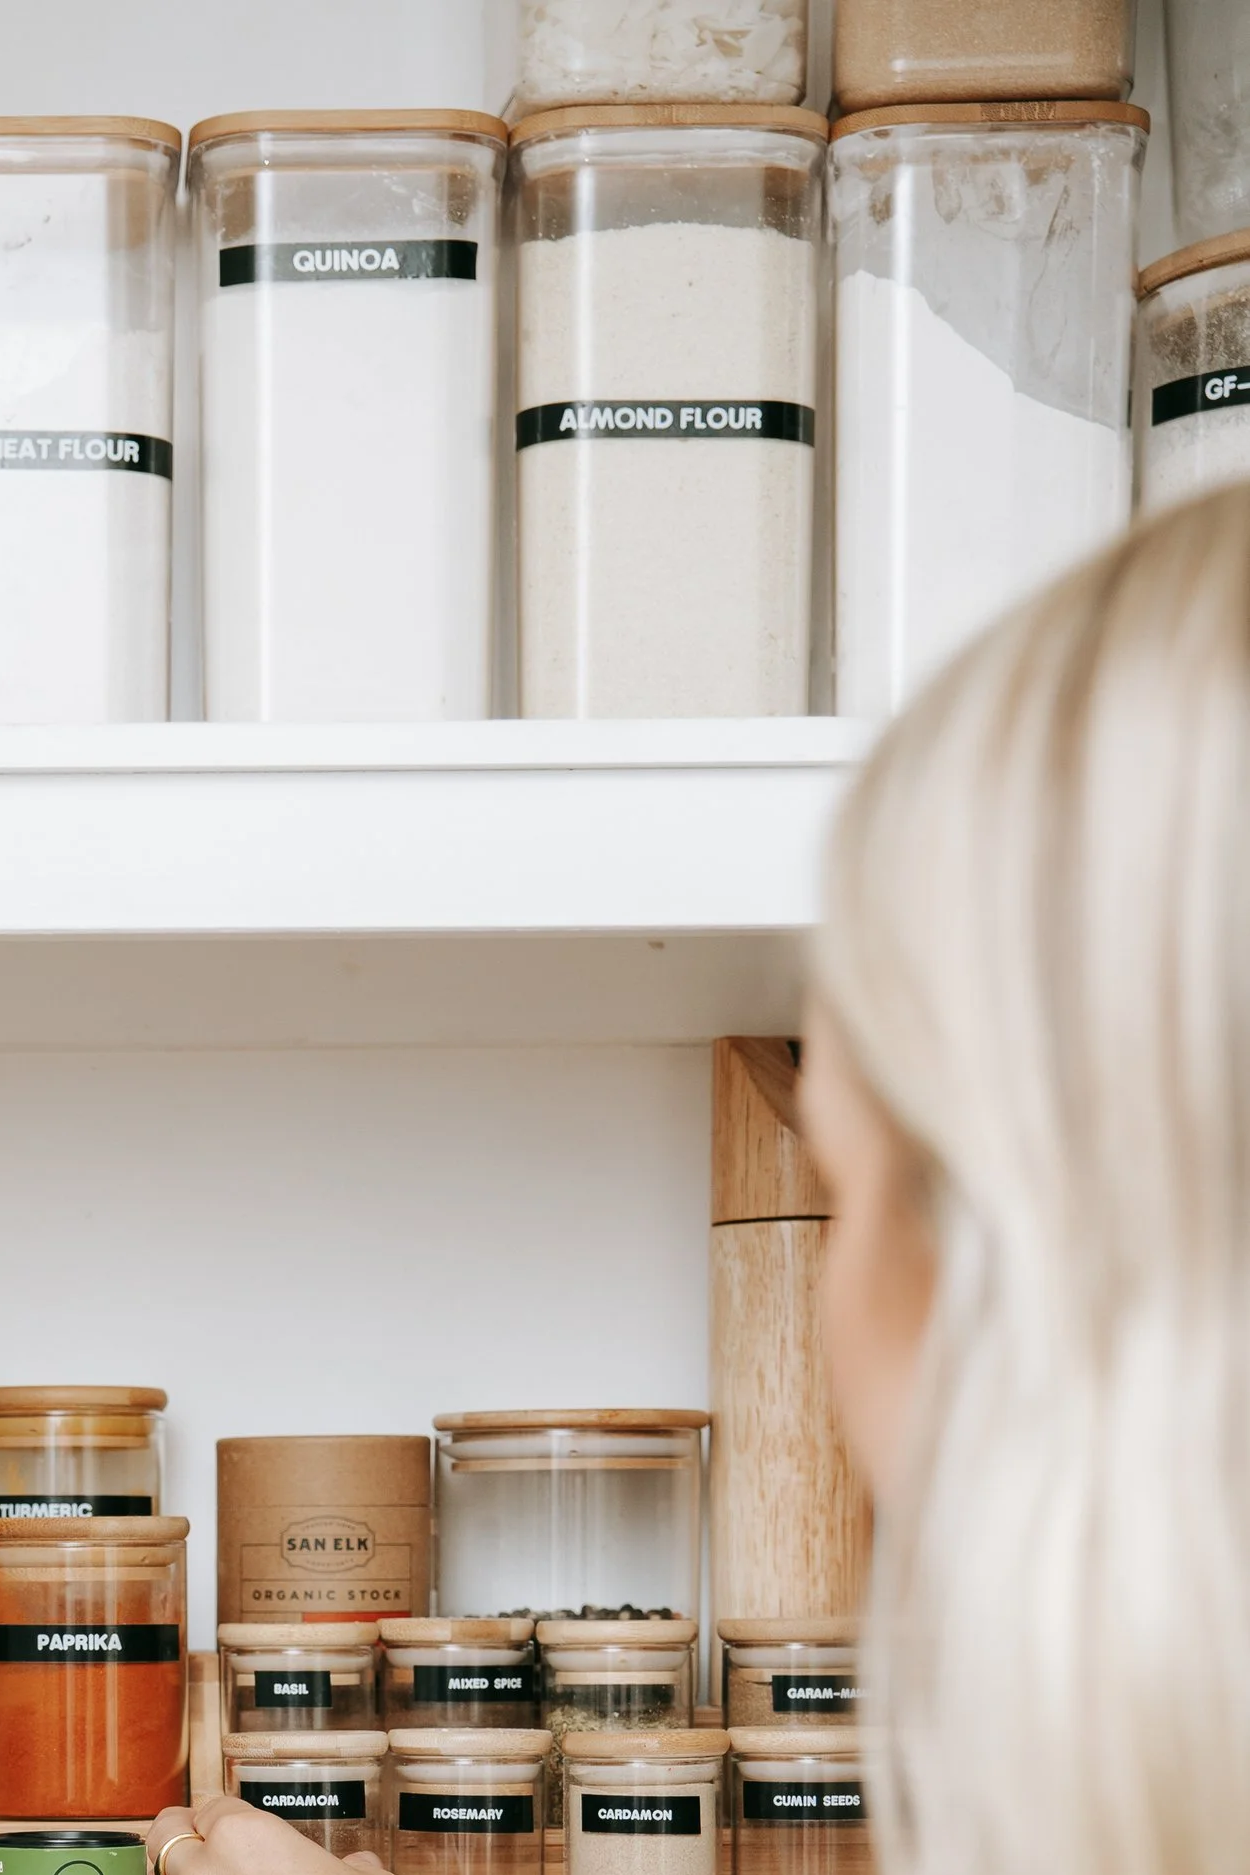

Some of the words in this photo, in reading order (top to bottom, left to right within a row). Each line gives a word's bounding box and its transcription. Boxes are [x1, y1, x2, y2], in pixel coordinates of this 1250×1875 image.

[293, 248, 399, 273] QUINOA
[559, 408, 672, 432] ALMOND
[680, 407, 761, 431] FLOUR
[58, 439, 139, 464] FLOUR
[0, 1503, 93, 1518] TURMERIC
[287, 1538, 326, 1550] SAN
[334, 1538, 368, 1550] ELK
[252, 1590, 336, 1600] ORGANIC
[348, 1590, 401, 1600] STOCK
[37, 1633, 122, 1651] PAPRIKA
[274, 1683, 309, 1695] BASIL
[448, 1678, 488, 1690] MIXED
[494, 1677, 522, 1689] SPICE
[262, 1795, 339, 1806] CARDAMOM
[773, 1795, 816, 1807] CUMIN
[823, 1795, 860, 1806] SEEDS
[433, 1808, 503, 1820] ROSEMARY
[598, 1809, 672, 1821] CARDAMON
